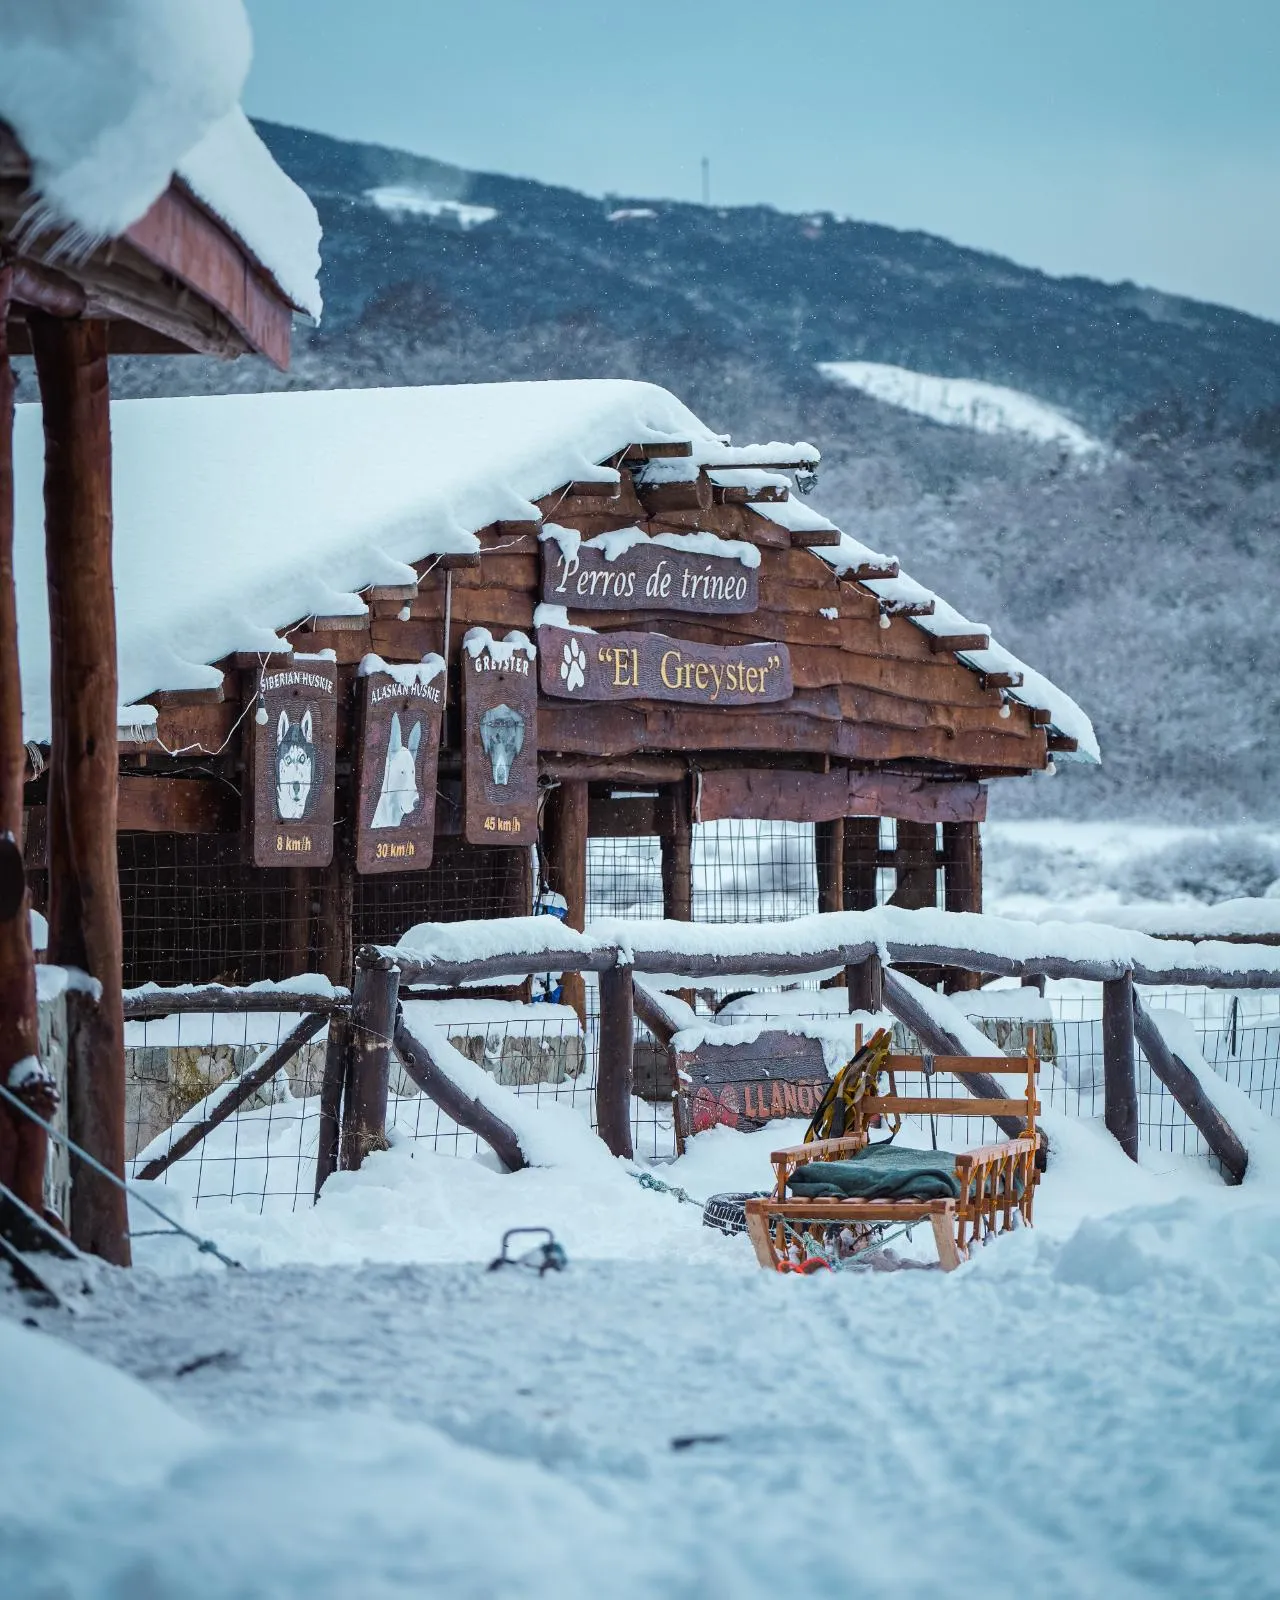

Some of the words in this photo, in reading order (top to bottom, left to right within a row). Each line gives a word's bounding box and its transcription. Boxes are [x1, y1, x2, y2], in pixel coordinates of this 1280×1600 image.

[555, 554, 636, 598] Perros
[646, 560, 672, 598] de
[681, 564, 748, 601] trineo
[260, 671, 301, 693] SIBERIAN
[301, 671, 334, 694] HUSKIE
[371, 683, 409, 705] ALASKAN
[410, 682, 441, 704] HUSKIE
[484, 816, 496, 831] 45
[497, 816, 521, 833] km/h
[276, 836, 283, 851] 8
[286, 836, 311, 852] km/h
[376, 843, 388, 858] 30
[390, 841, 415, 857] km/h
